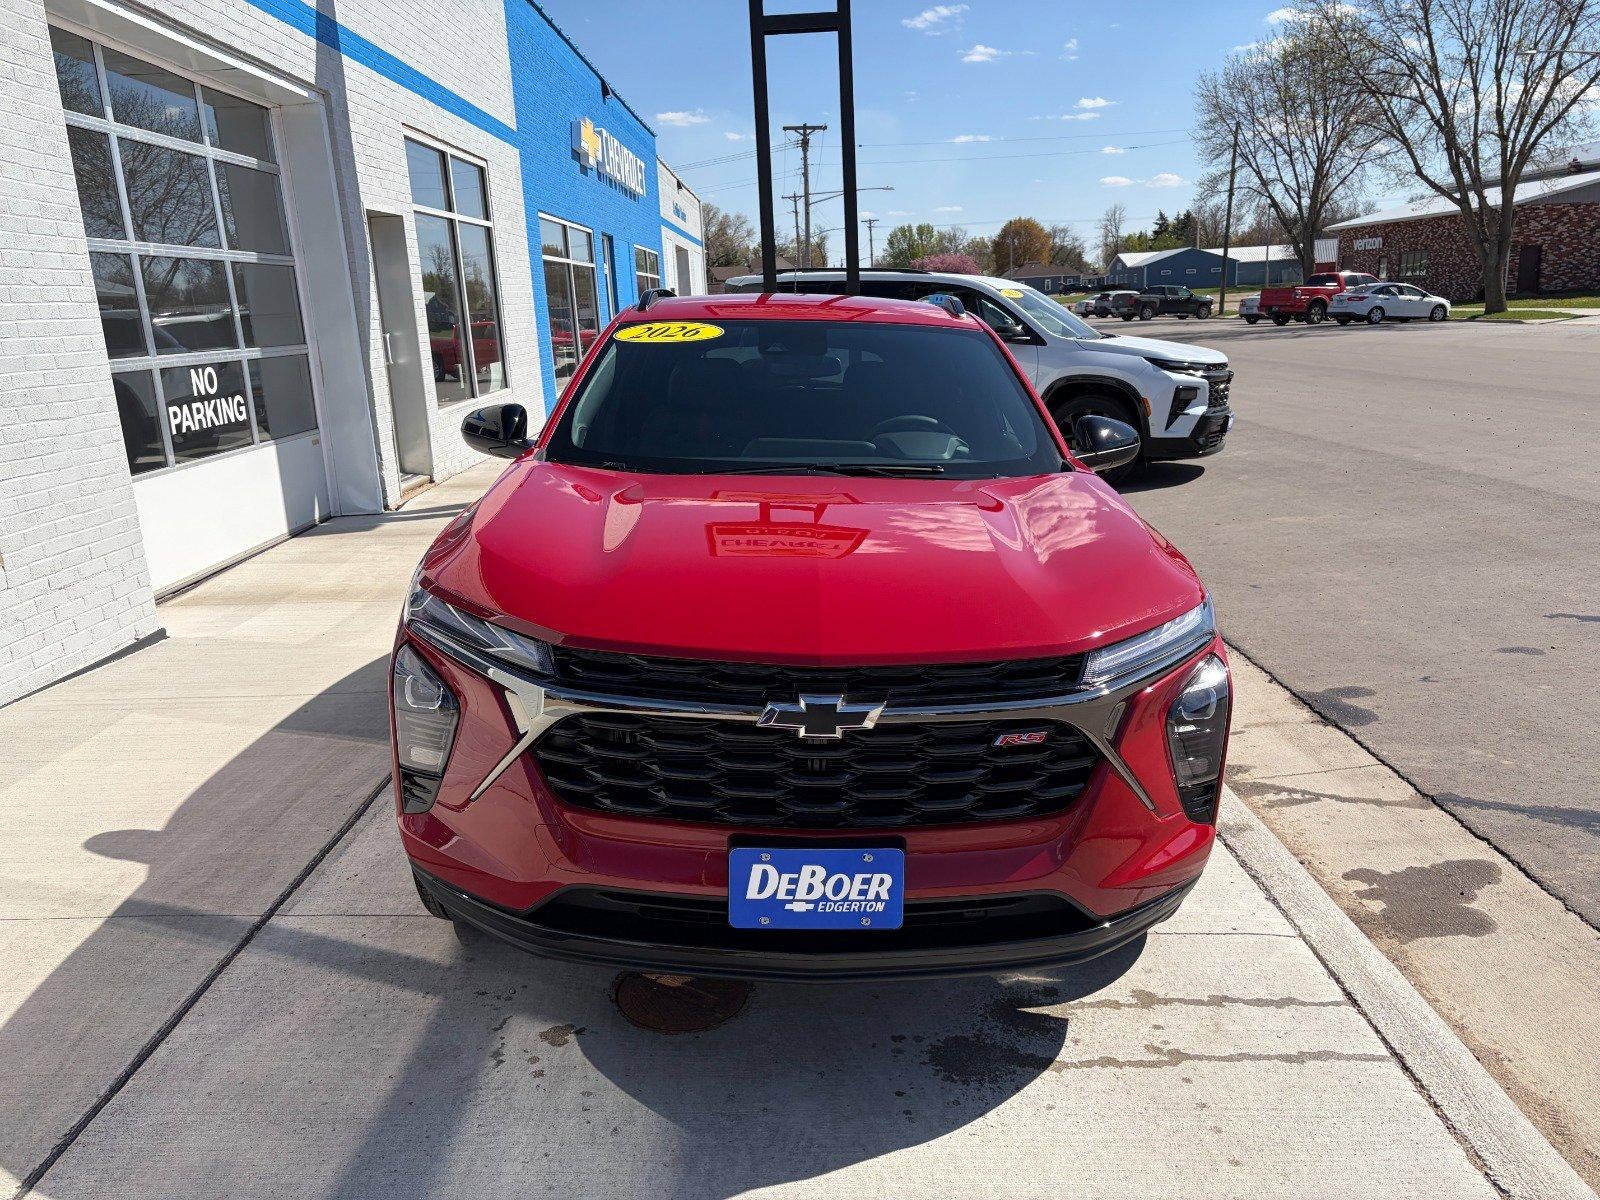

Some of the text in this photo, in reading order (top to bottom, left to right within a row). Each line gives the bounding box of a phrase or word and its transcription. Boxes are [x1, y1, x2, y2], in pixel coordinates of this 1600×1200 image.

[600, 128, 646, 197] CHEVROLET
[1353, 236, 1383, 250] verizon
[628, 325, 705, 340] 2026
[190, 366, 218, 397] NO
[168, 394, 248, 435] PARKING
[993, 731, 1048, 747] RS
[817, 901, 886, 913] EDGERTON
